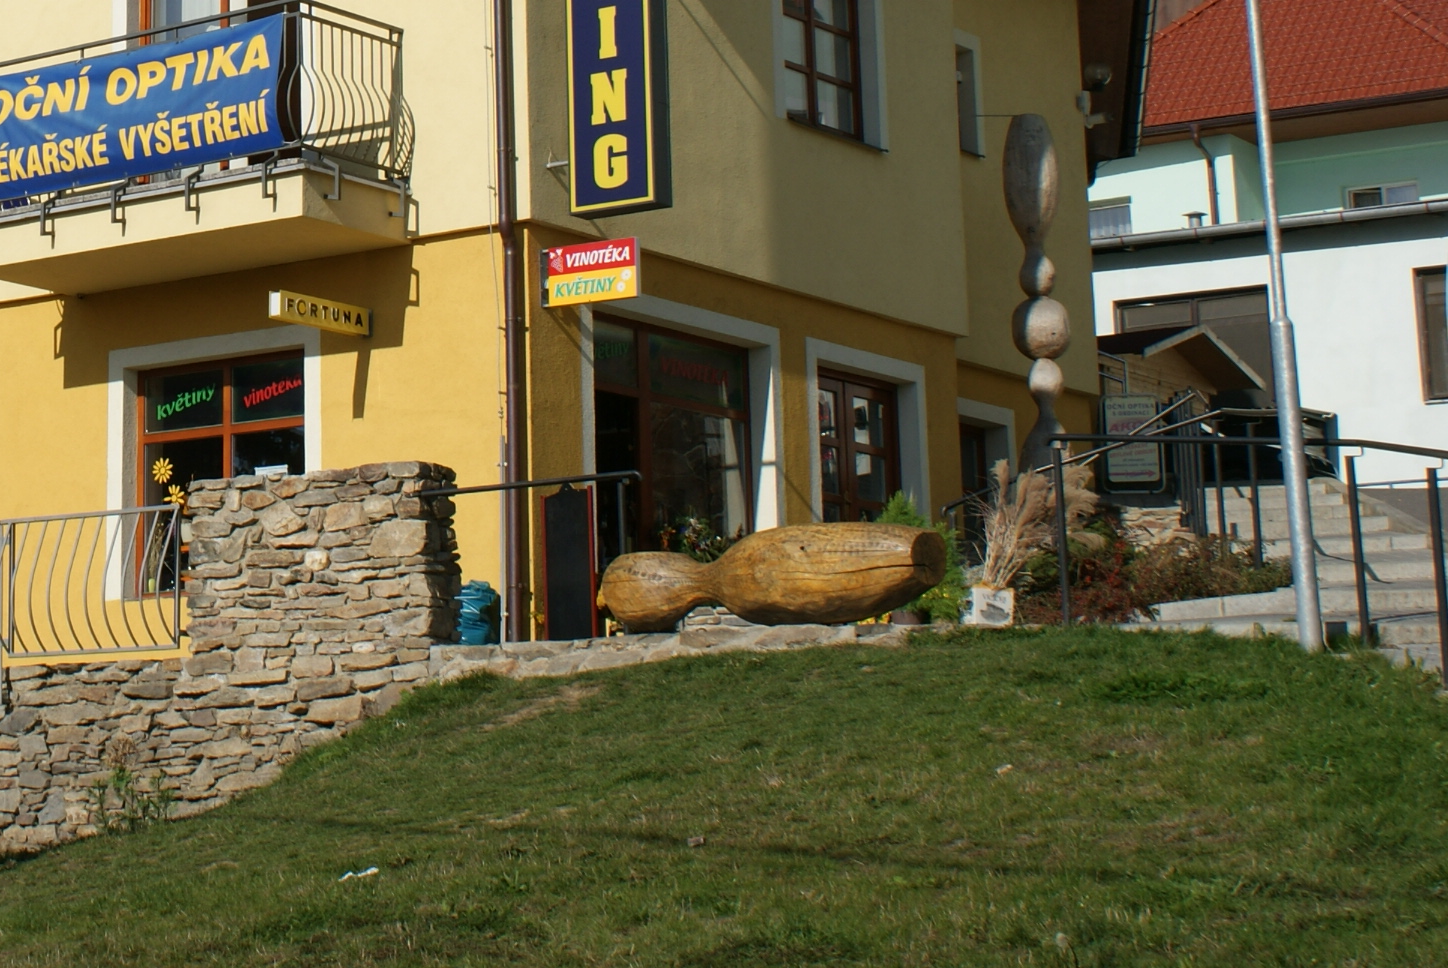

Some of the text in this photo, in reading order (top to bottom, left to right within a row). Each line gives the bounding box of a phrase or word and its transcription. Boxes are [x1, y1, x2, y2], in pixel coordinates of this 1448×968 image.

[105, 33, 271, 106] OPTIKA
[119, 88, 271, 162] VYŠETŘENÍ
[565, 244, 631, 268] VINOTÉKA
[554, 277, 617, 299] KVĚTINY
[285, 297, 364, 328] FORTUNA
[156, 382, 216, 421] květiny
